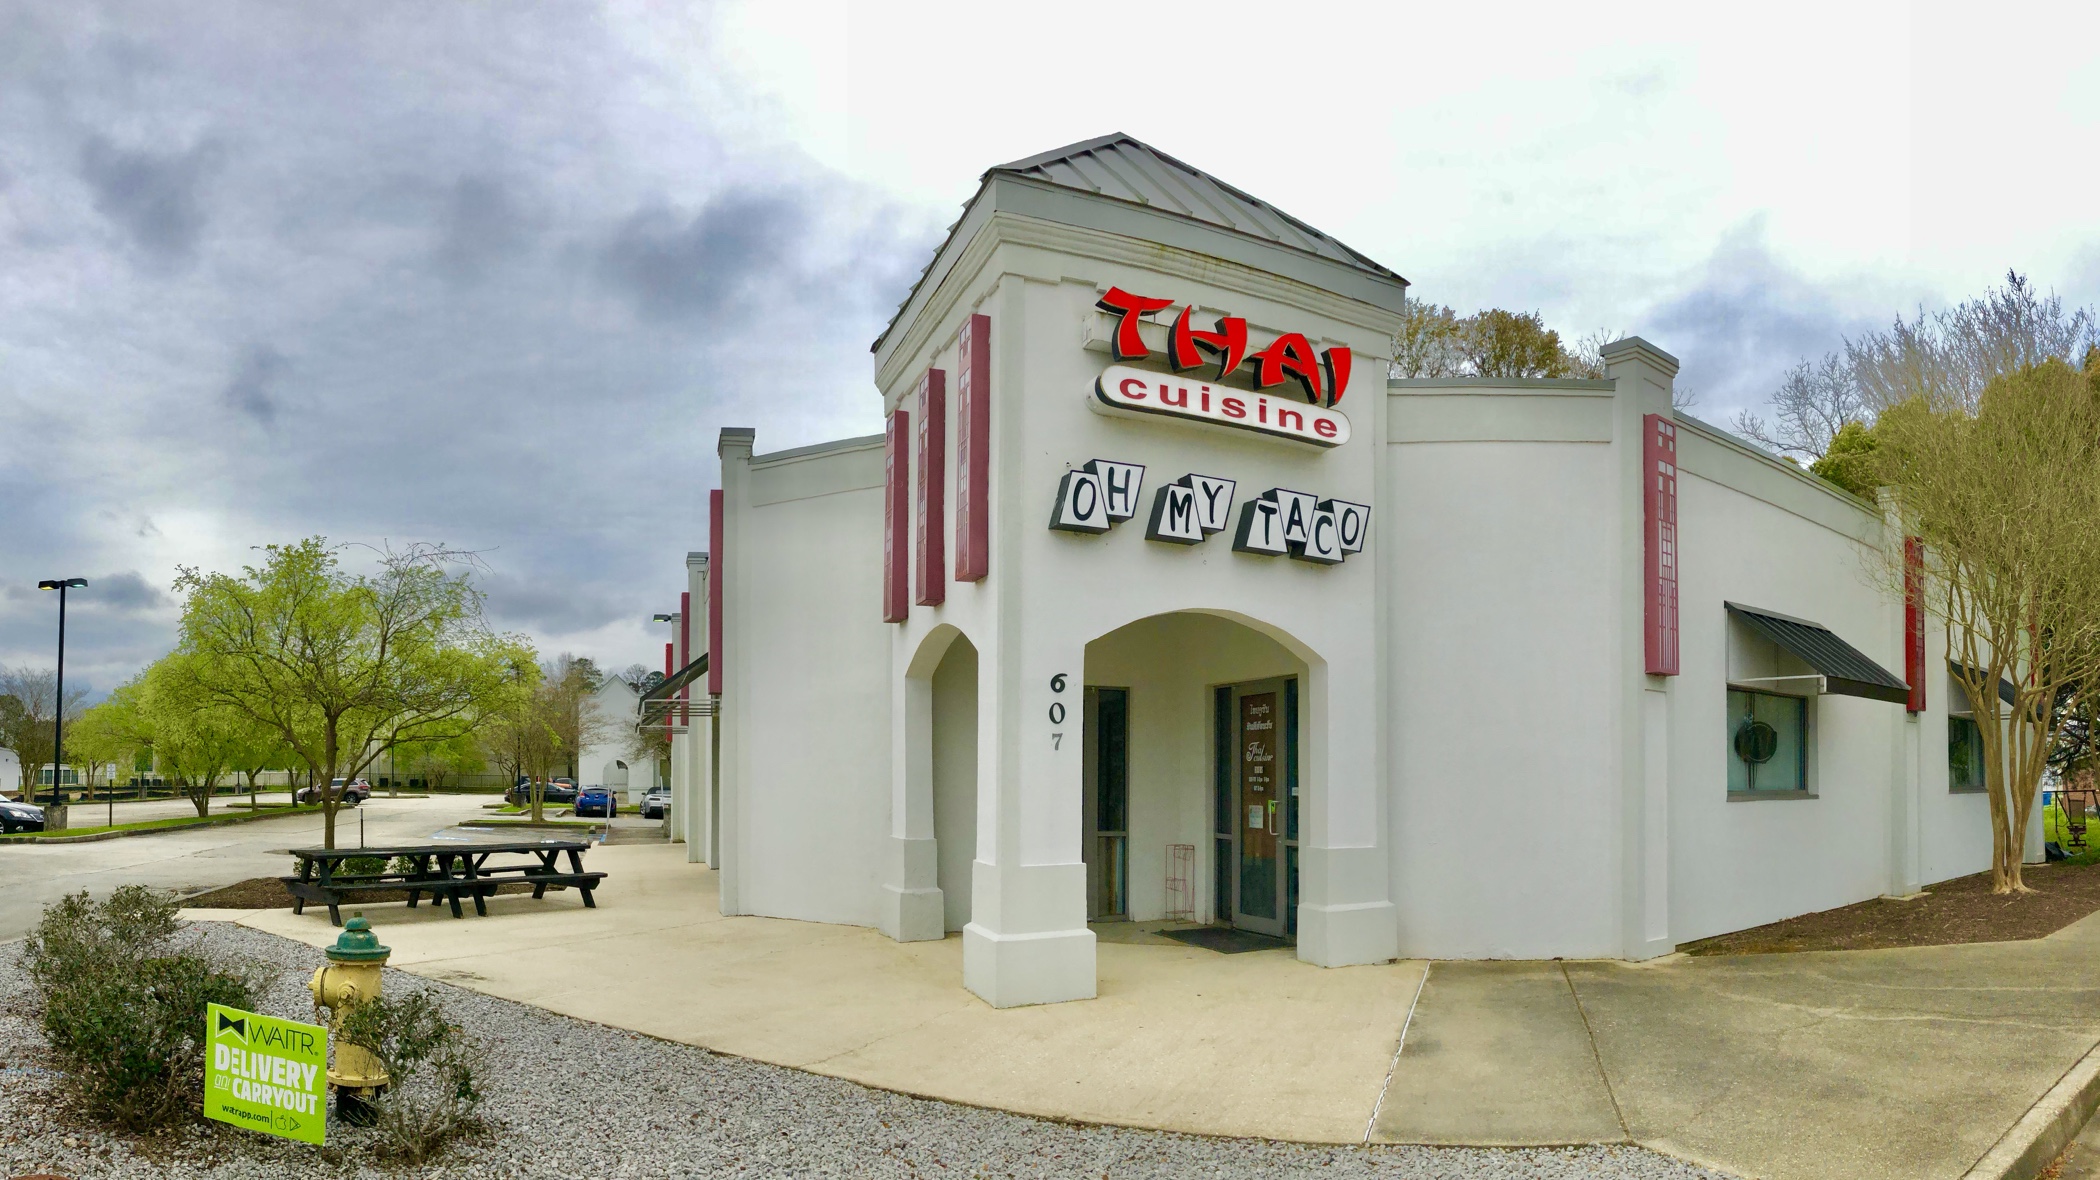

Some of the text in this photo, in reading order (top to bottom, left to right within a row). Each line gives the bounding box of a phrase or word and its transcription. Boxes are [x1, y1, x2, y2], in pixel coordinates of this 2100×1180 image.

[1095, 286, 1352, 408] THAI
[1119, 377, 1338, 438] cuisine
[1072, 466, 1360, 555] OH MY TACO
[248, 1021, 314, 1055] WAITR
[214, 1042, 318, 1092] DELIVERY
[232, 1077, 318, 1115] CARRYOUT
